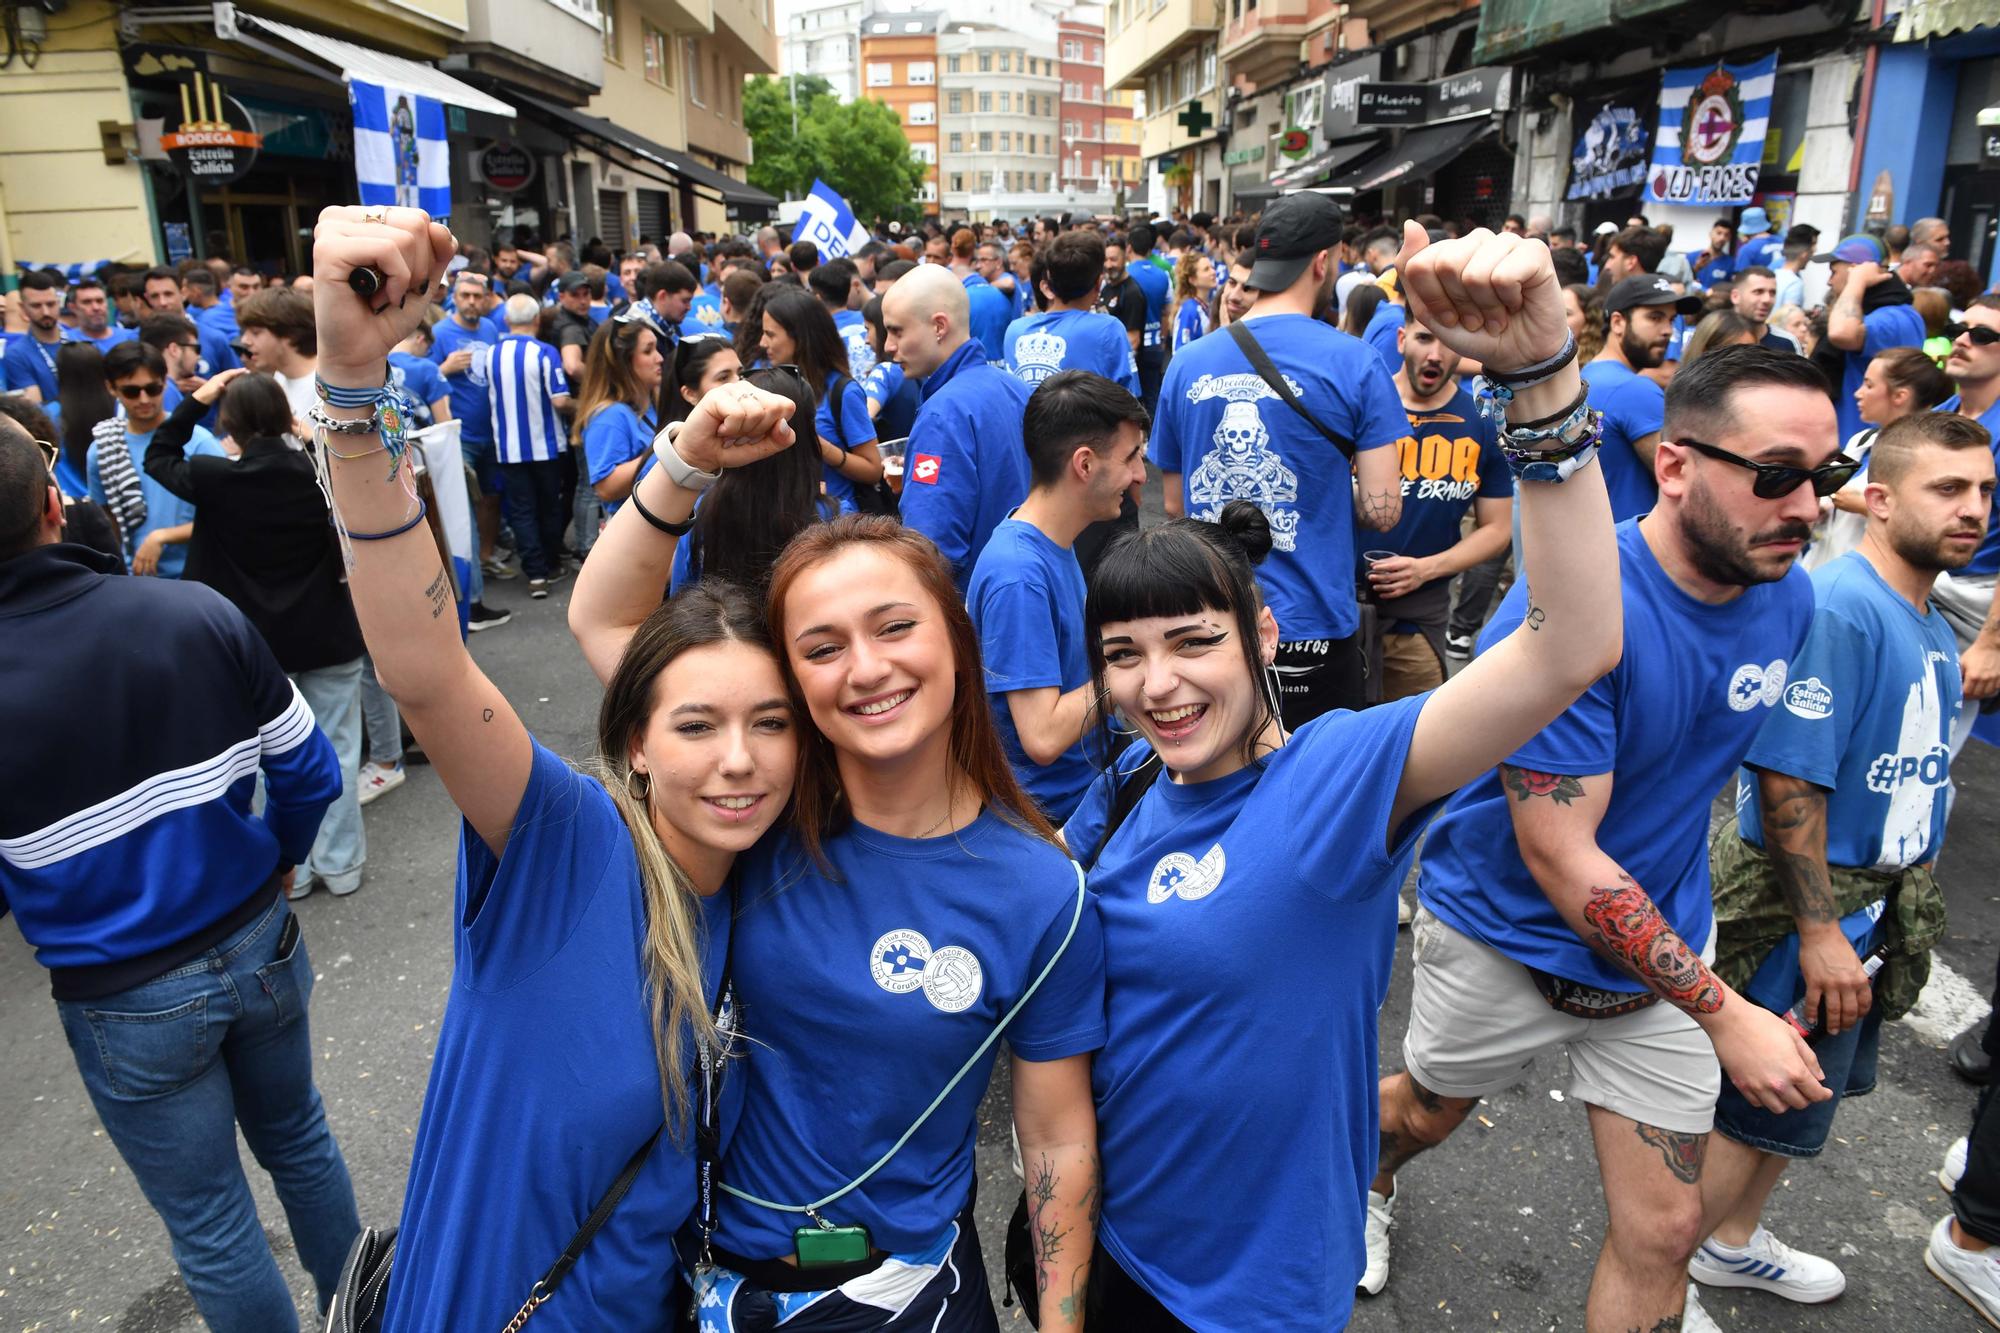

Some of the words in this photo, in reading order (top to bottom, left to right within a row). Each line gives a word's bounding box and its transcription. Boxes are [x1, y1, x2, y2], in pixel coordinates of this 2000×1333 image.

[175, 133, 236, 146] BODEGA
[190, 160, 235, 175] Galicia
[1699, 164, 1759, 200] FACES
[1790, 695, 1827, 713] Galicia
[1791, 685, 1831, 704] Estrella
[874, 942, 885, 960] Real
[883, 933, 899, 945] Club
[901, 931, 929, 954] Deportivo
[935, 948, 962, 963] RIAZOR
[963, 952, 980, 977] BLUES
[891, 978, 920, 991] Coruña
[924, 974, 943, 1007] SEMPRE
[953, 990, 977, 1010] DEPOR
